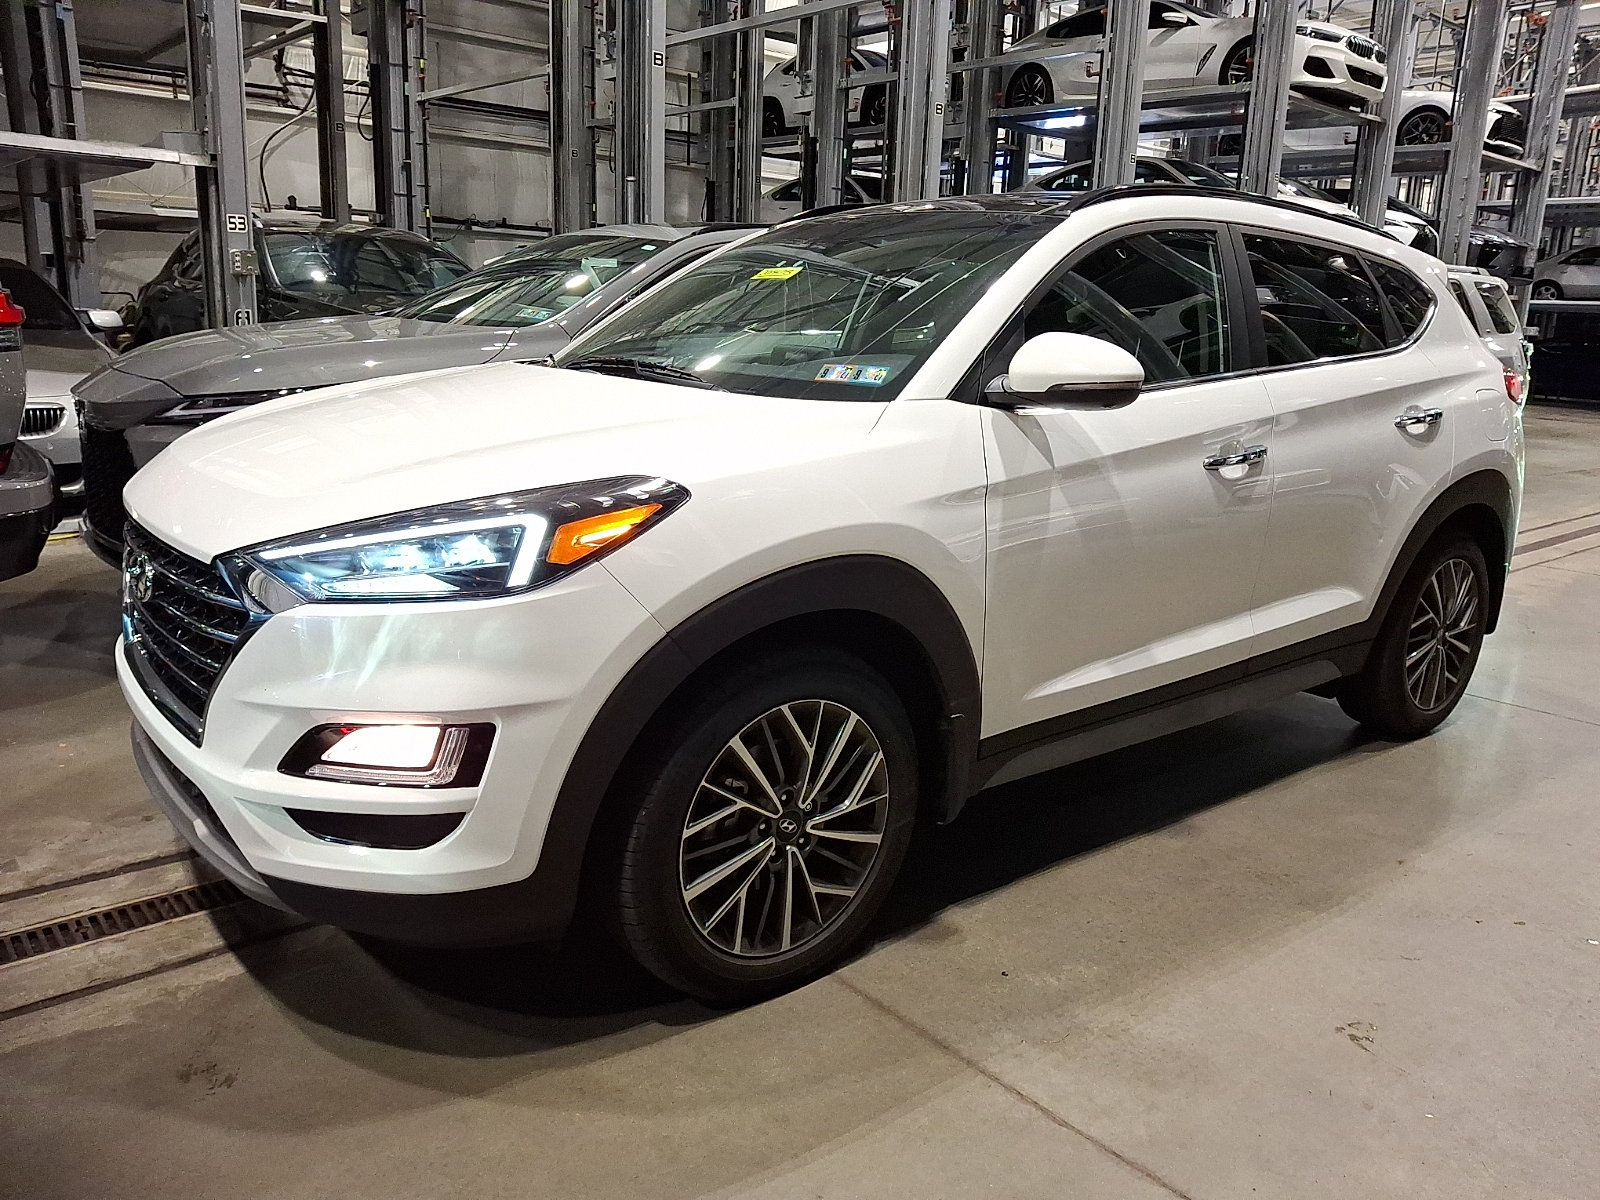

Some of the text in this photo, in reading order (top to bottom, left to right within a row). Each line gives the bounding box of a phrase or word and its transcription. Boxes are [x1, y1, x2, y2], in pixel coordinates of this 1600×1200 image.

[654, 51, 664, 66] B
[336, 122, 345, 132] B
[572, 149, 579, 158] B
[228, 216, 247, 231] 53
[820, 368, 830, 379] 9
[853, 369, 863, 381] 9
